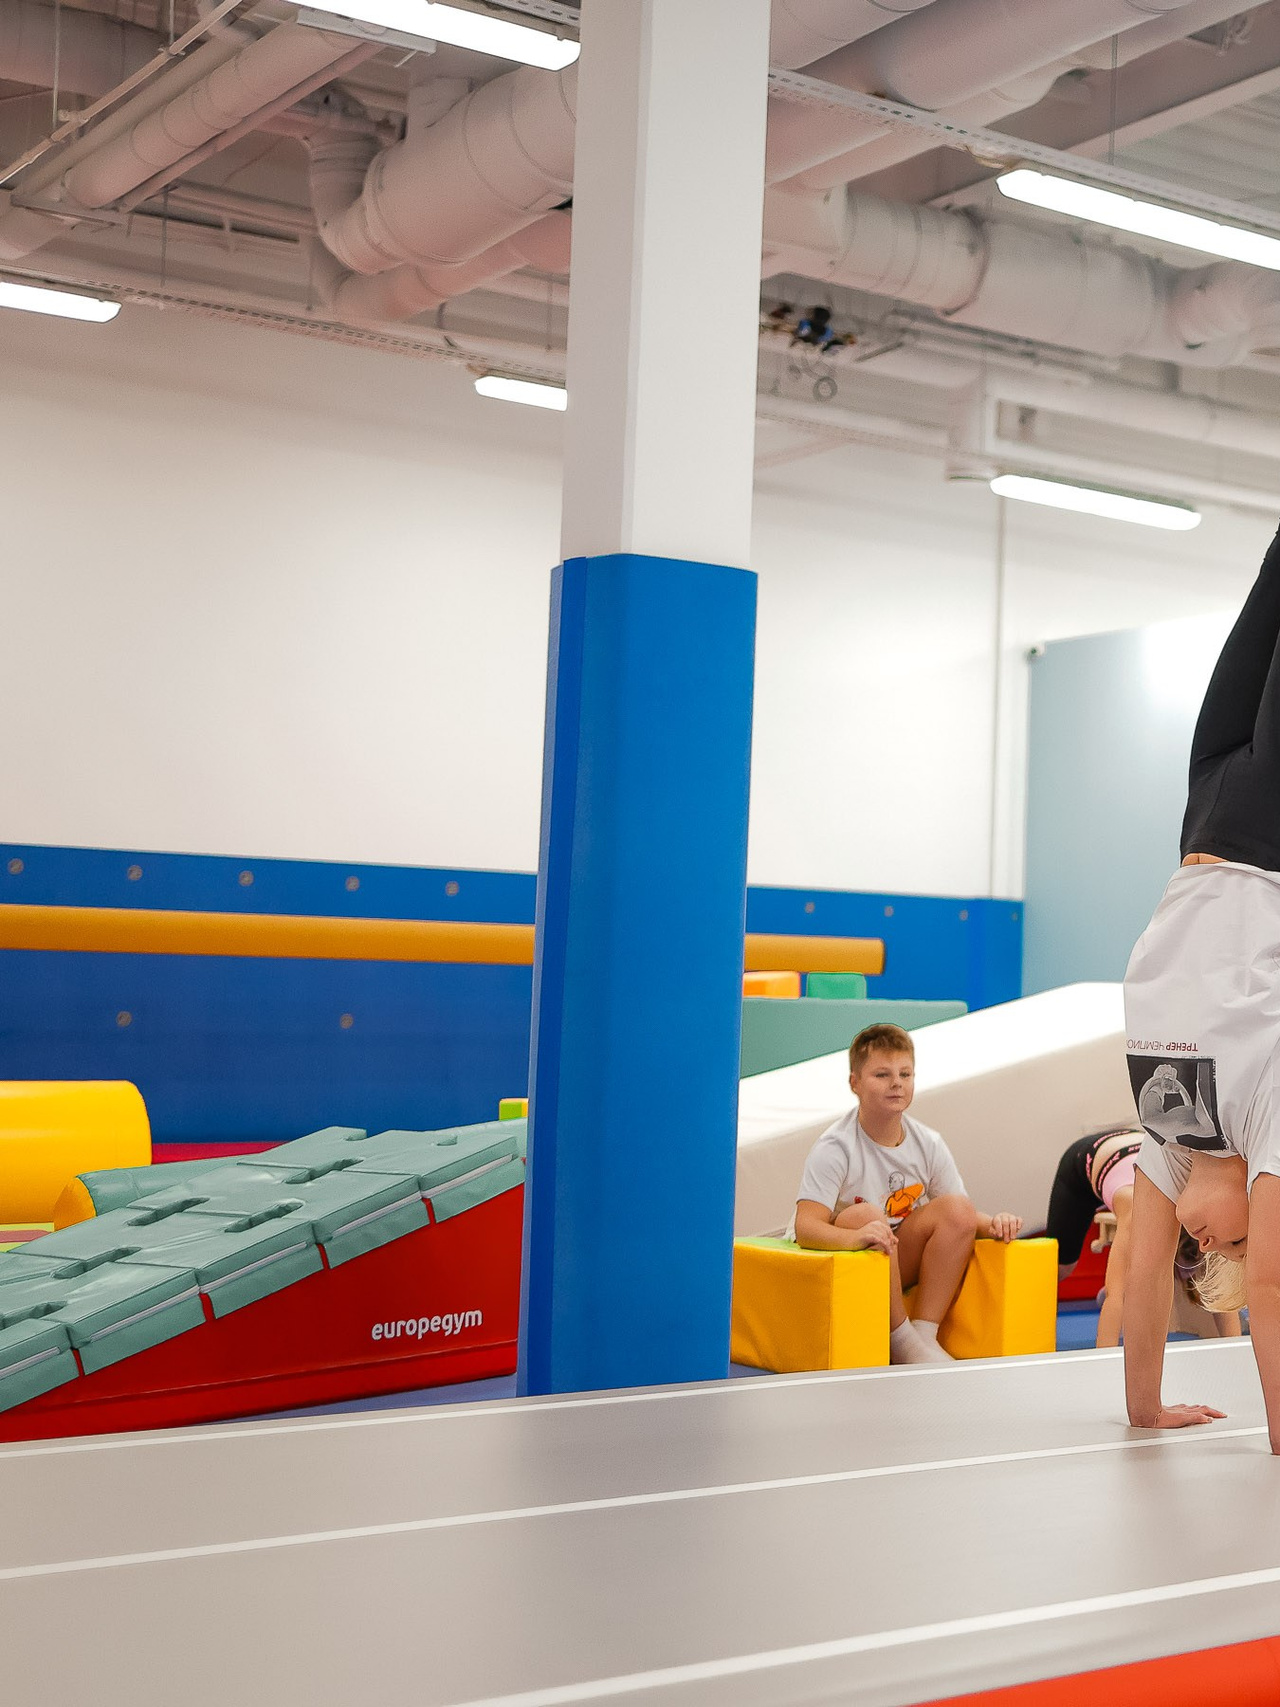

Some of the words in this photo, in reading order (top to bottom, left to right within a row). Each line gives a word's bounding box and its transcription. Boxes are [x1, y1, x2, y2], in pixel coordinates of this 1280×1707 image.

[1127, 1039, 1165, 1051] ЧЕМПИО
[1166, 1042, 1198, 1052] ТРЕНЕР
[371, 1309, 483, 1340] europegym
